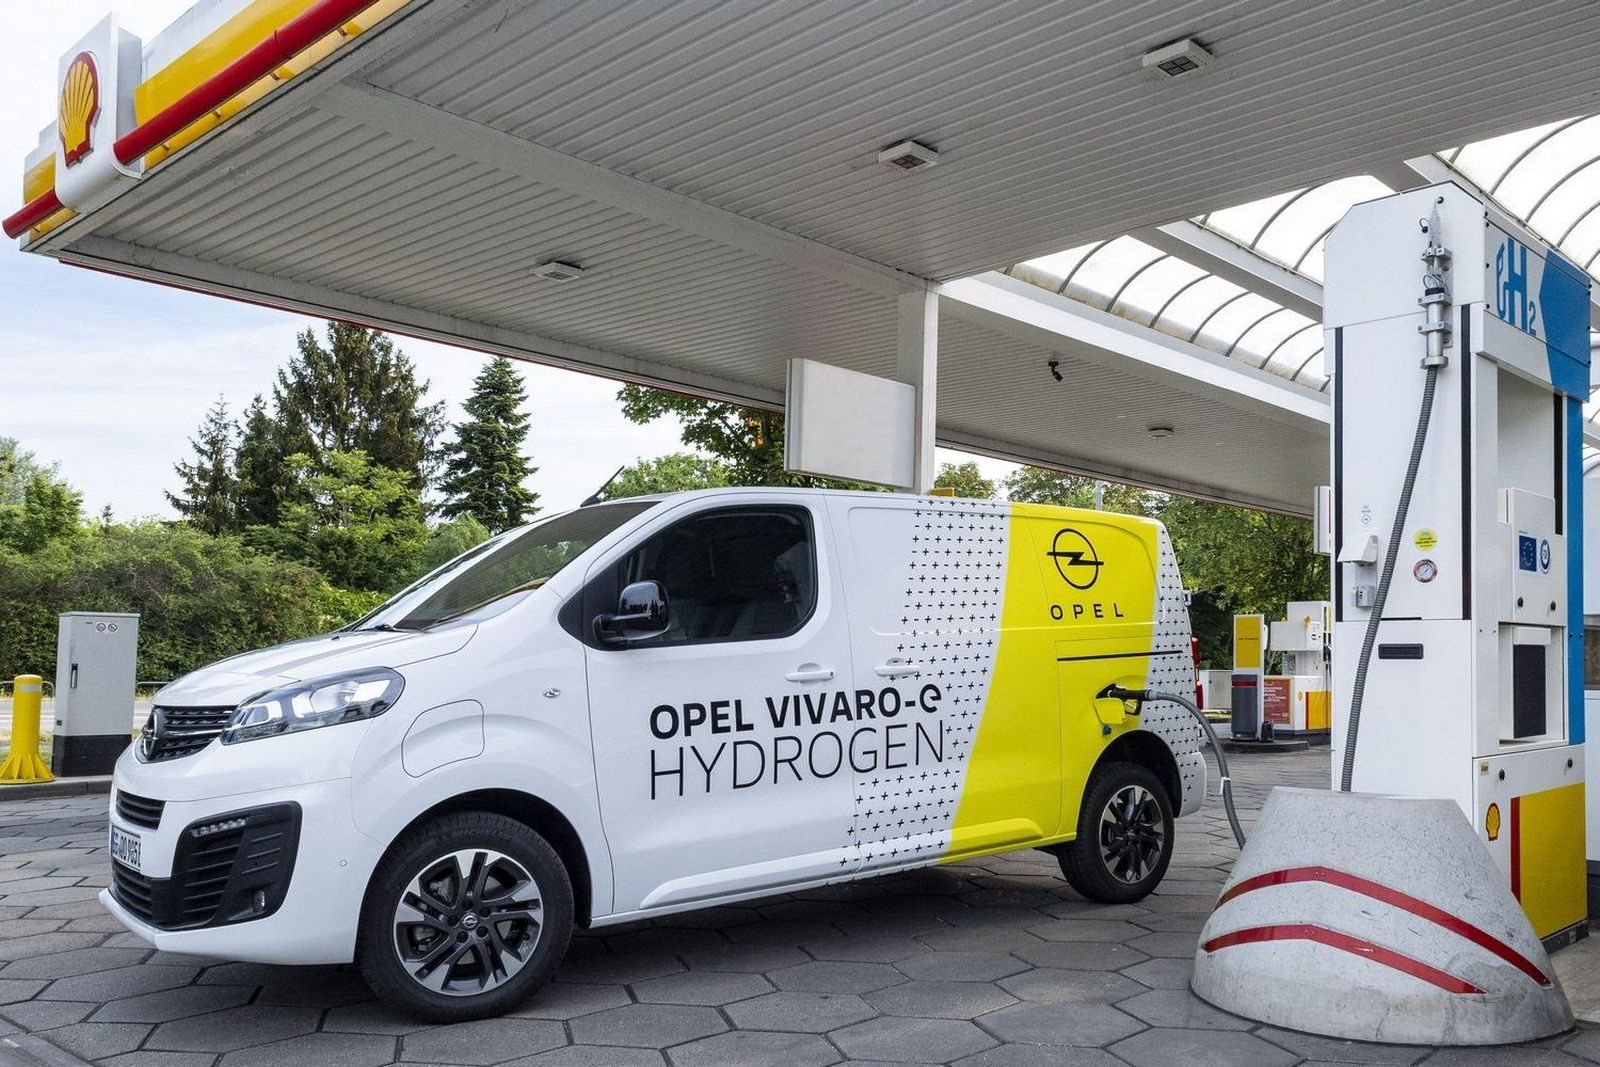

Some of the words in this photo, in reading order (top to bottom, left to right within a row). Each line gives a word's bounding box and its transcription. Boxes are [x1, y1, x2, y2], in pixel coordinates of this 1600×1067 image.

[1050, 603, 1124, 621] OPEL
[650, 699, 754, 740] OPEL
[765, 683, 942, 728] VIVARO-e
[650, 719, 944, 800] HYDROGEN
